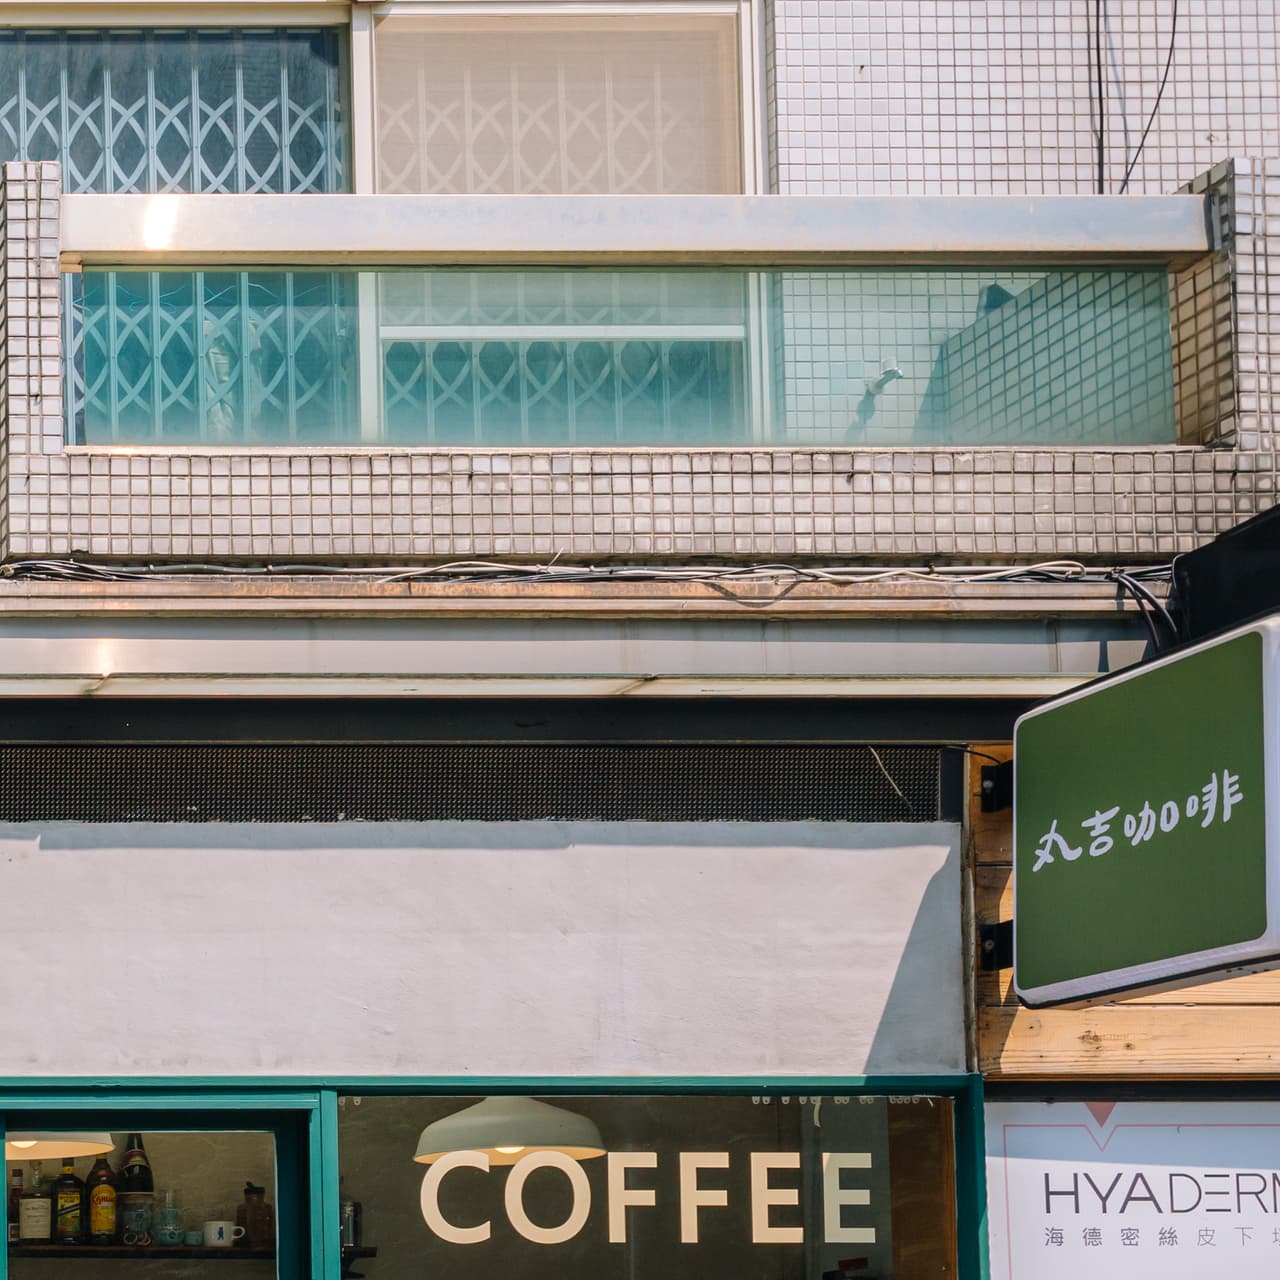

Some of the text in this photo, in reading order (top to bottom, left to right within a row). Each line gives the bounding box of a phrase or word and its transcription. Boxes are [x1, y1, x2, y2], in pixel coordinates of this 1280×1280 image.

[1032, 769, 1244, 872] 丸吉咖啡
[420, 1150, 876, 1244] COFFEE
[1044, 1172, 1279, 1214] HYADER
